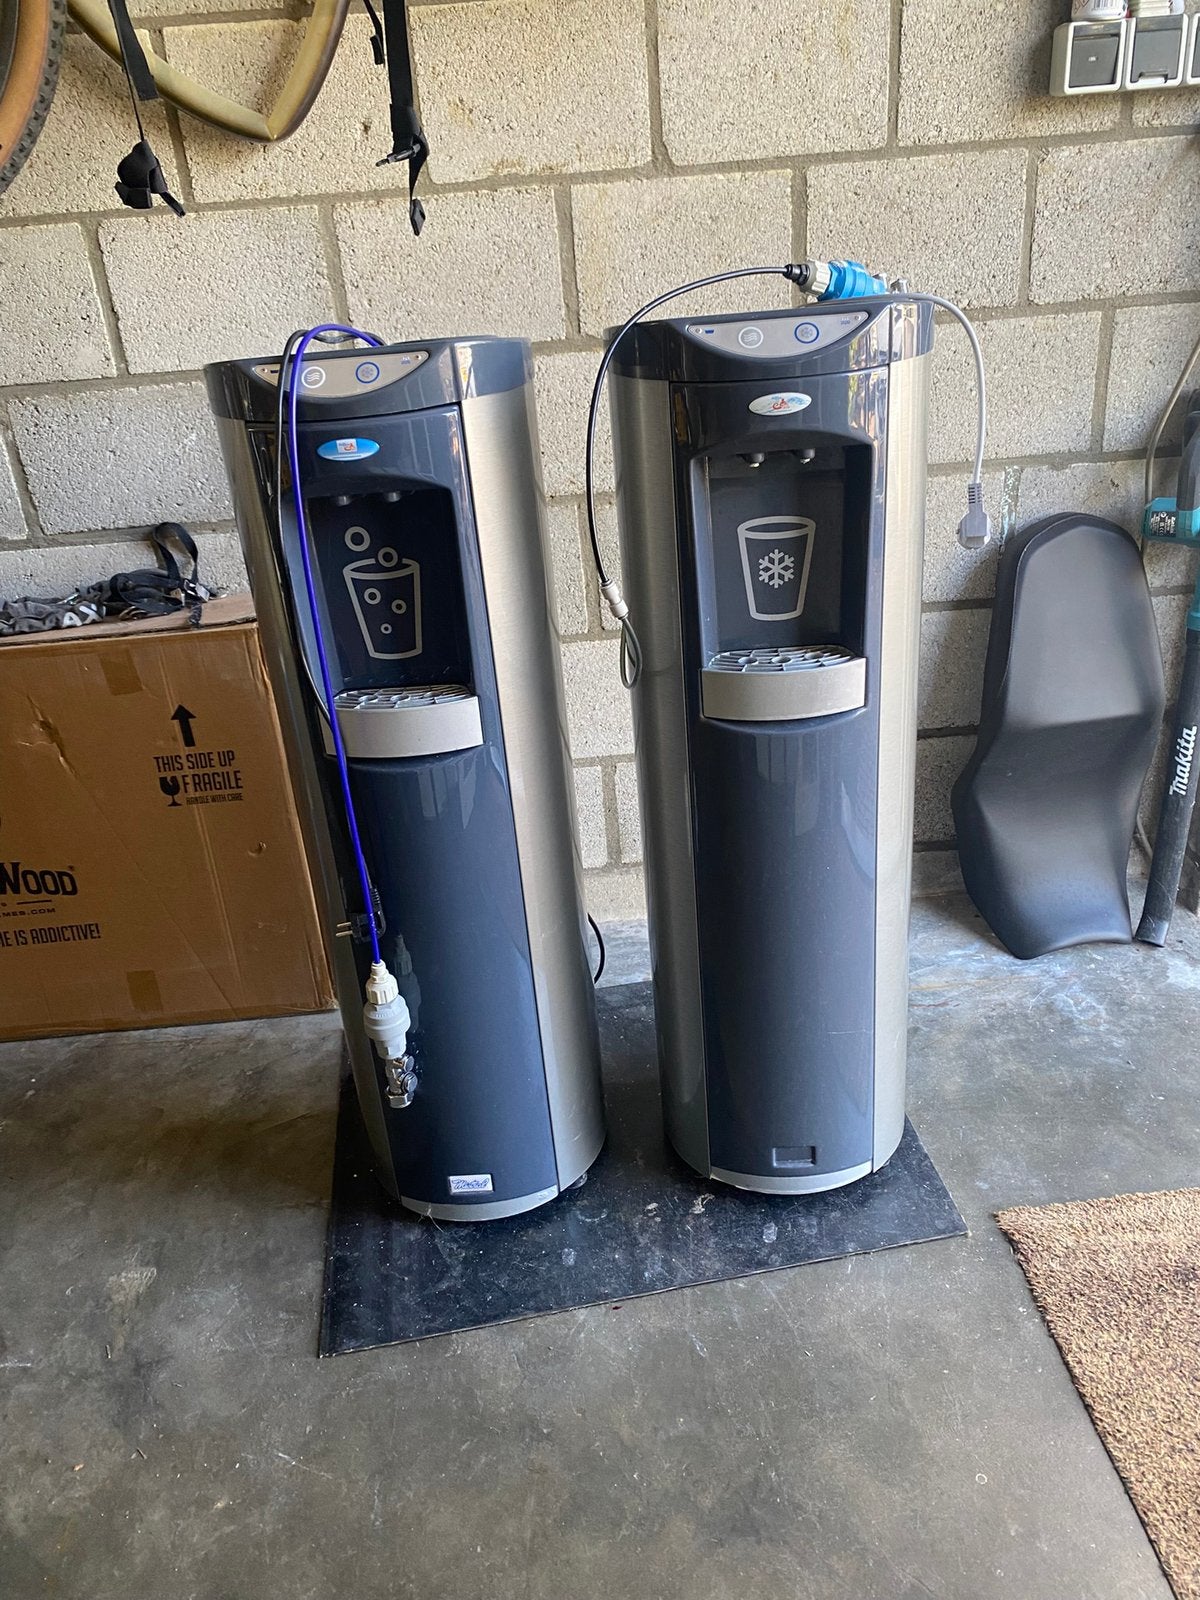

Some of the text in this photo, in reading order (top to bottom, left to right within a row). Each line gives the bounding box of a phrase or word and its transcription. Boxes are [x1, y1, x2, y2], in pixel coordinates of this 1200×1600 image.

[153, 750, 235, 773] THIS SIDE UP
[1169, 726, 1198, 796] Makita
[181, 770, 244, 794] FRAGILE
[14, 929, 28, 946] IS
[30, 922, 101, 945] ADDICTIVE!
